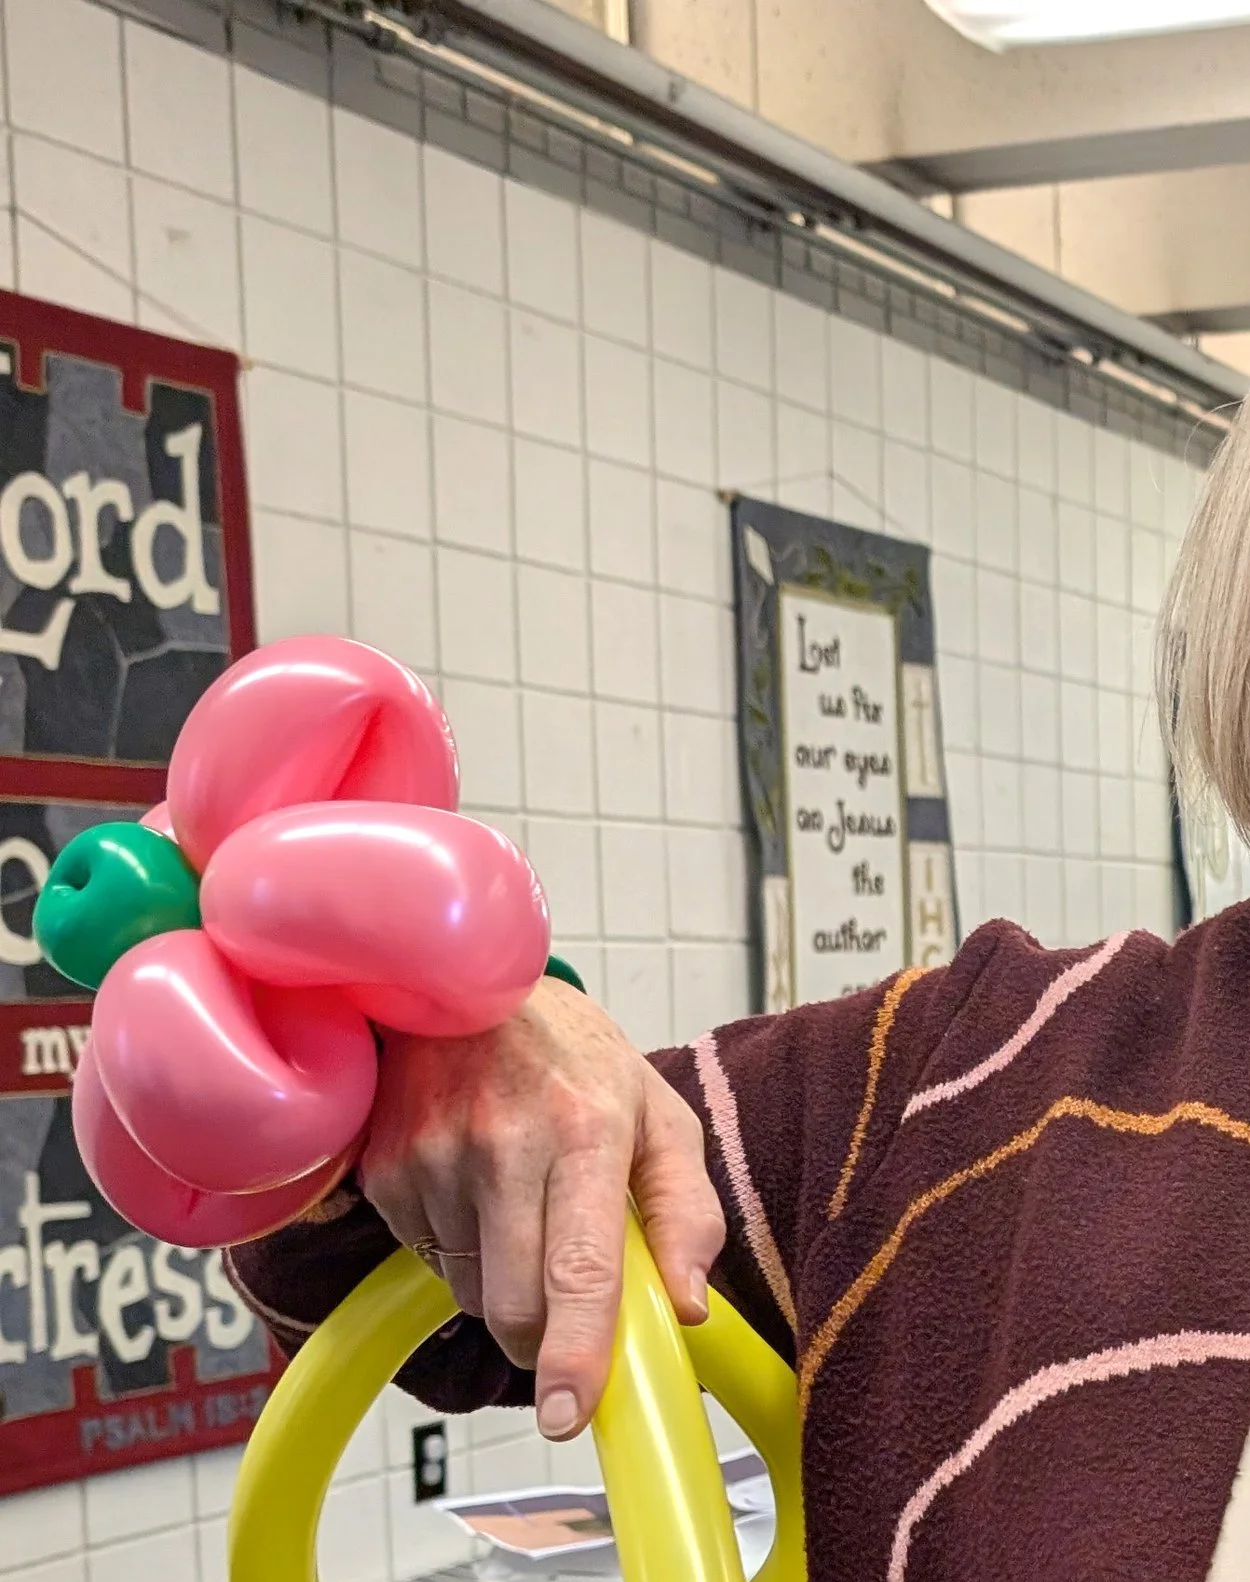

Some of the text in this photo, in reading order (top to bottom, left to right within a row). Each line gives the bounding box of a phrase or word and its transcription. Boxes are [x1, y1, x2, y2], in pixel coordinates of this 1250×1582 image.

[0, 423, 220, 671] ord
[818, 684, 883, 724] us fix
[796, 744, 893, 790] our eyes
[797, 798, 896, 855] on Jesus
[852, 859, 885, 896] the
[812, 916, 887, 954] author
[79, 1399, 196, 1456] PSALM
